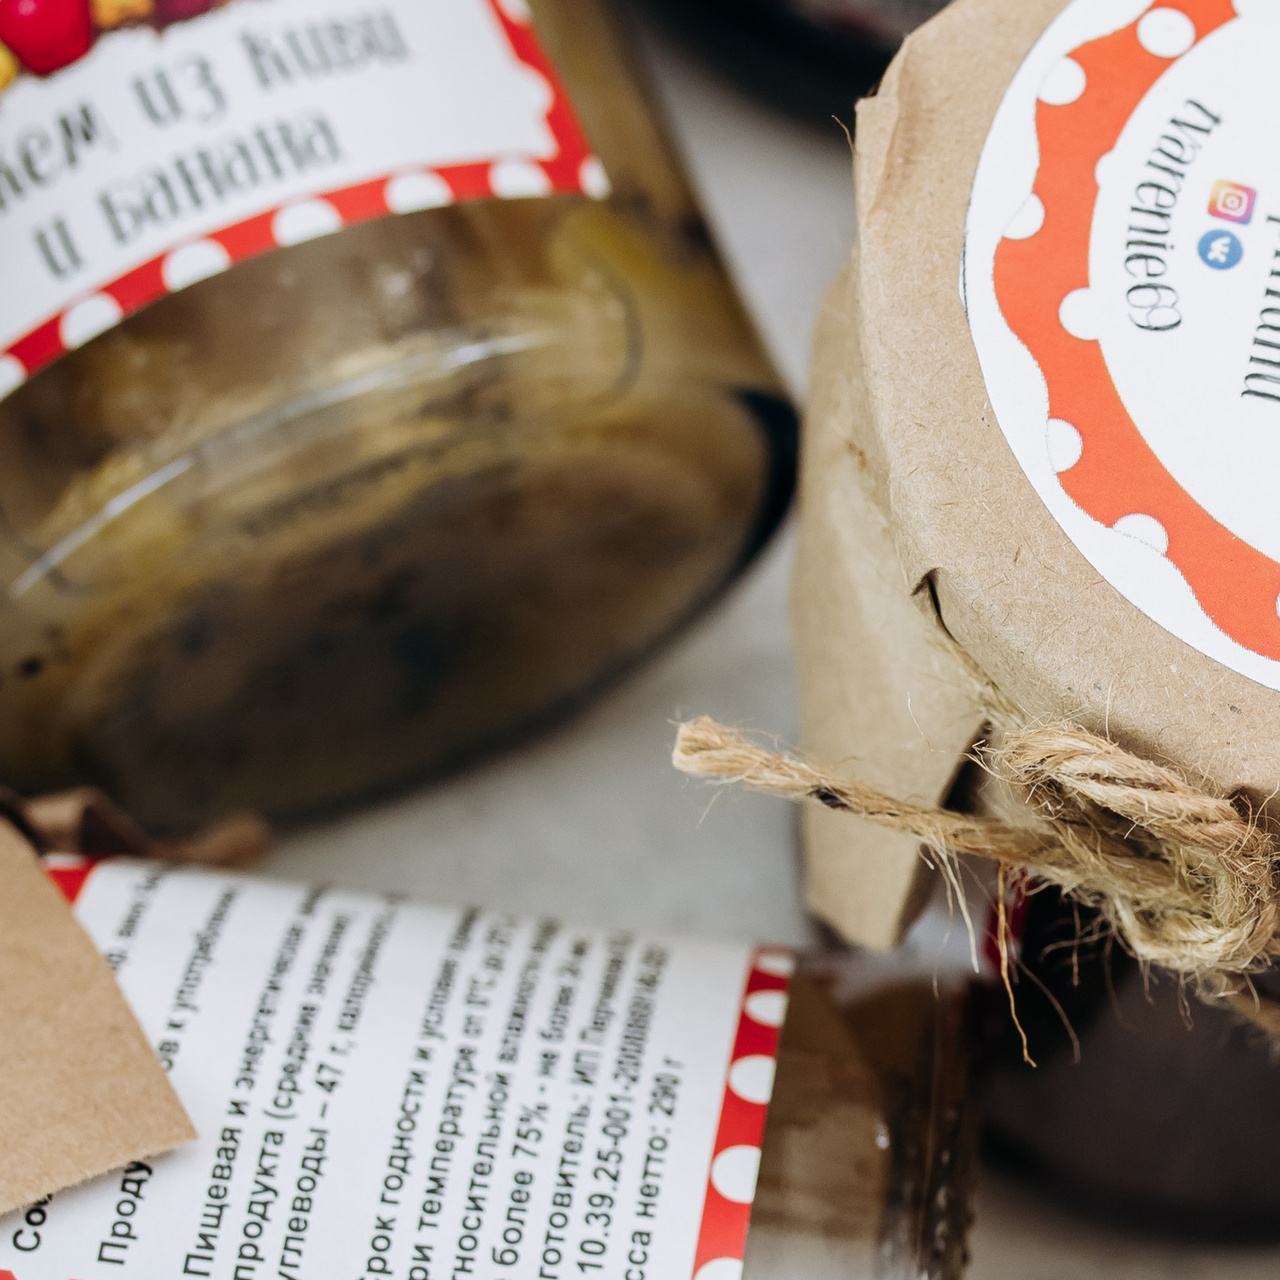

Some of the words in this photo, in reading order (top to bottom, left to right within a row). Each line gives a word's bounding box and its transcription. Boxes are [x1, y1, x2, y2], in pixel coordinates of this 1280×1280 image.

[314, 1062, 341, 1094] 47
[182, 1126, 242, 1278] Пищевая
[227, 1100, 248, 1117] и
[379, 1070, 426, 1206] годности
[416, 1045, 477, 1230] температуре
[635, 1121, 669, 1219] нетто:
[97, 1158, 154, 1265] Проду
[491, 1170, 535, 1267] более
